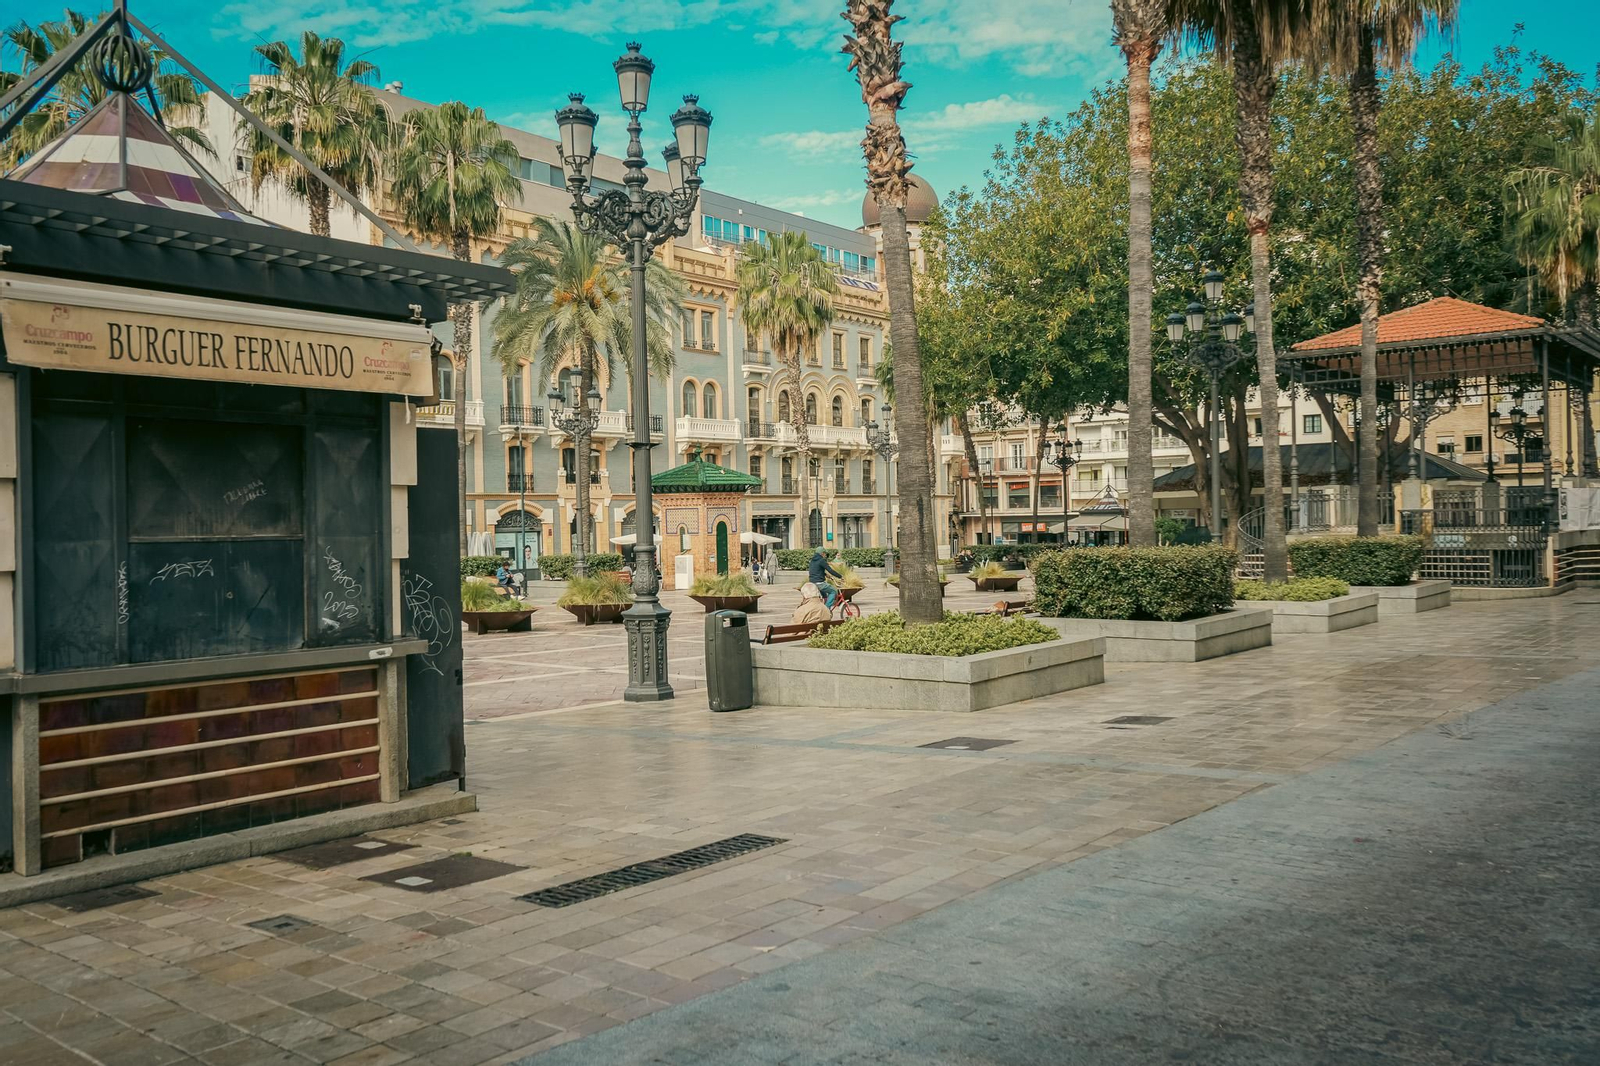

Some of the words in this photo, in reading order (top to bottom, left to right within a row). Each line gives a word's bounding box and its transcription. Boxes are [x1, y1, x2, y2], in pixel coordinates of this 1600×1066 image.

[24, 323, 93, 343] Cruzcampo
[106, 322, 229, 370] BURGUER
[234, 335, 354, 379] FERNANDO
